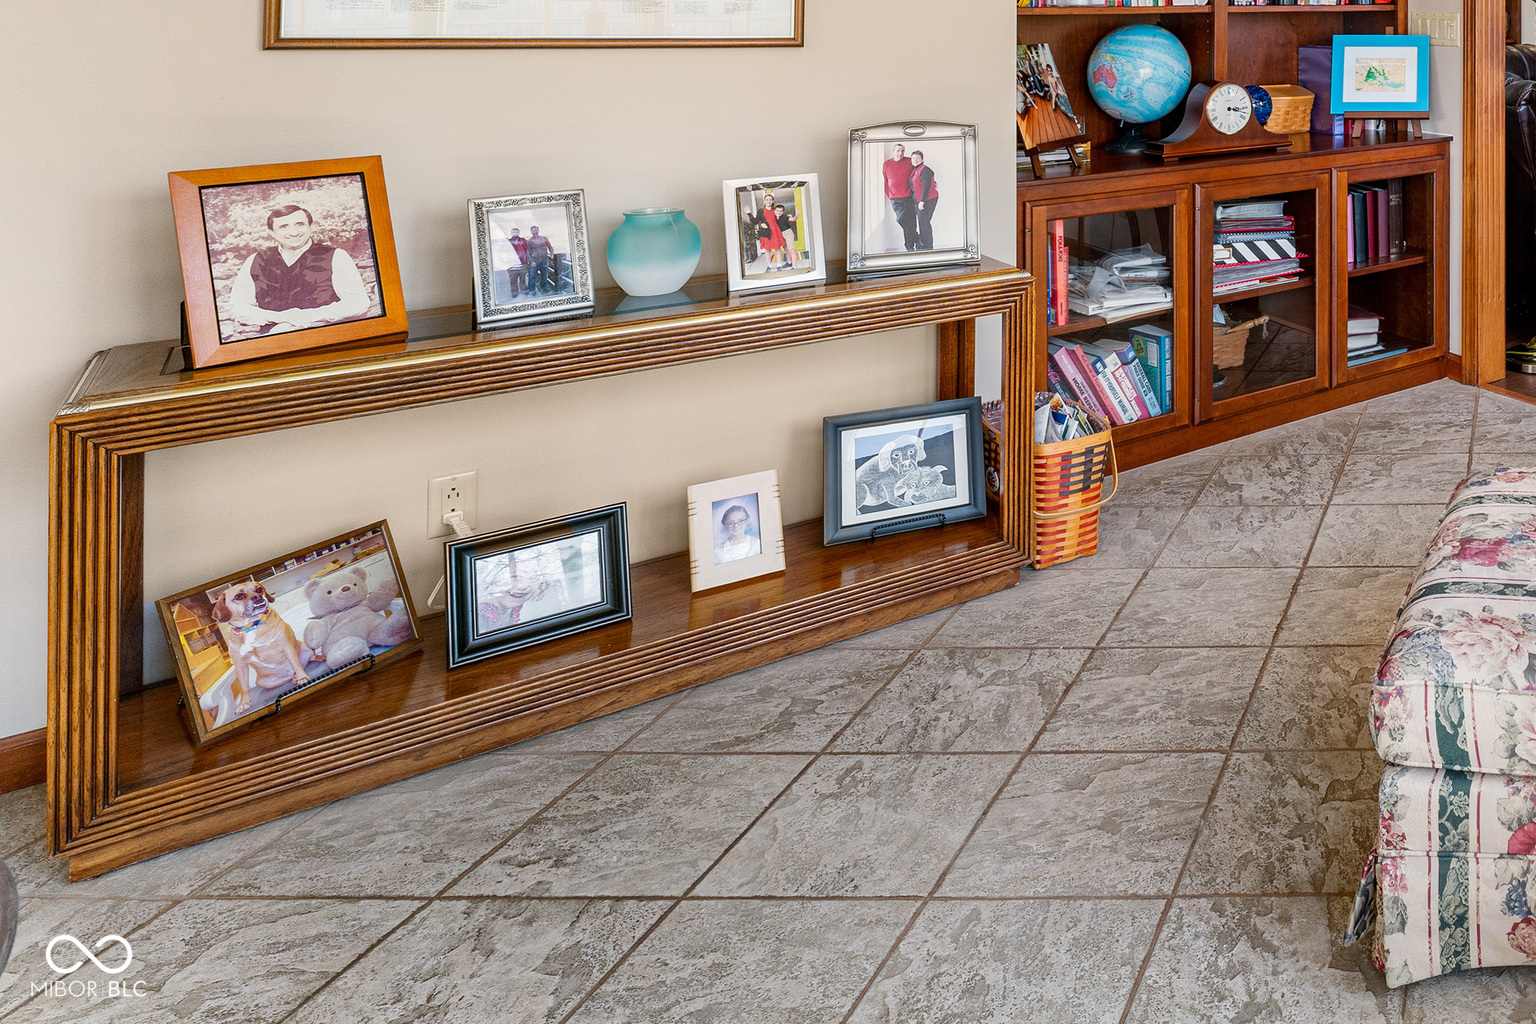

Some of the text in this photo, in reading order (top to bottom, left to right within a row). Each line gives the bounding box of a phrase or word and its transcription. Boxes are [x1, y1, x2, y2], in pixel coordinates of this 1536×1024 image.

[1071, 377, 1086, 396] HOME
[1132, 364, 1142, 378] PRICE
[1137, 376, 1146, 390] GUIDE
[1135, 361, 1147, 382] BASEBALL
[1144, 381, 1153, 394] CARD
[1106, 382, 1121, 401] YOURSELF
[1117, 398, 1129, 416] MANUAL
